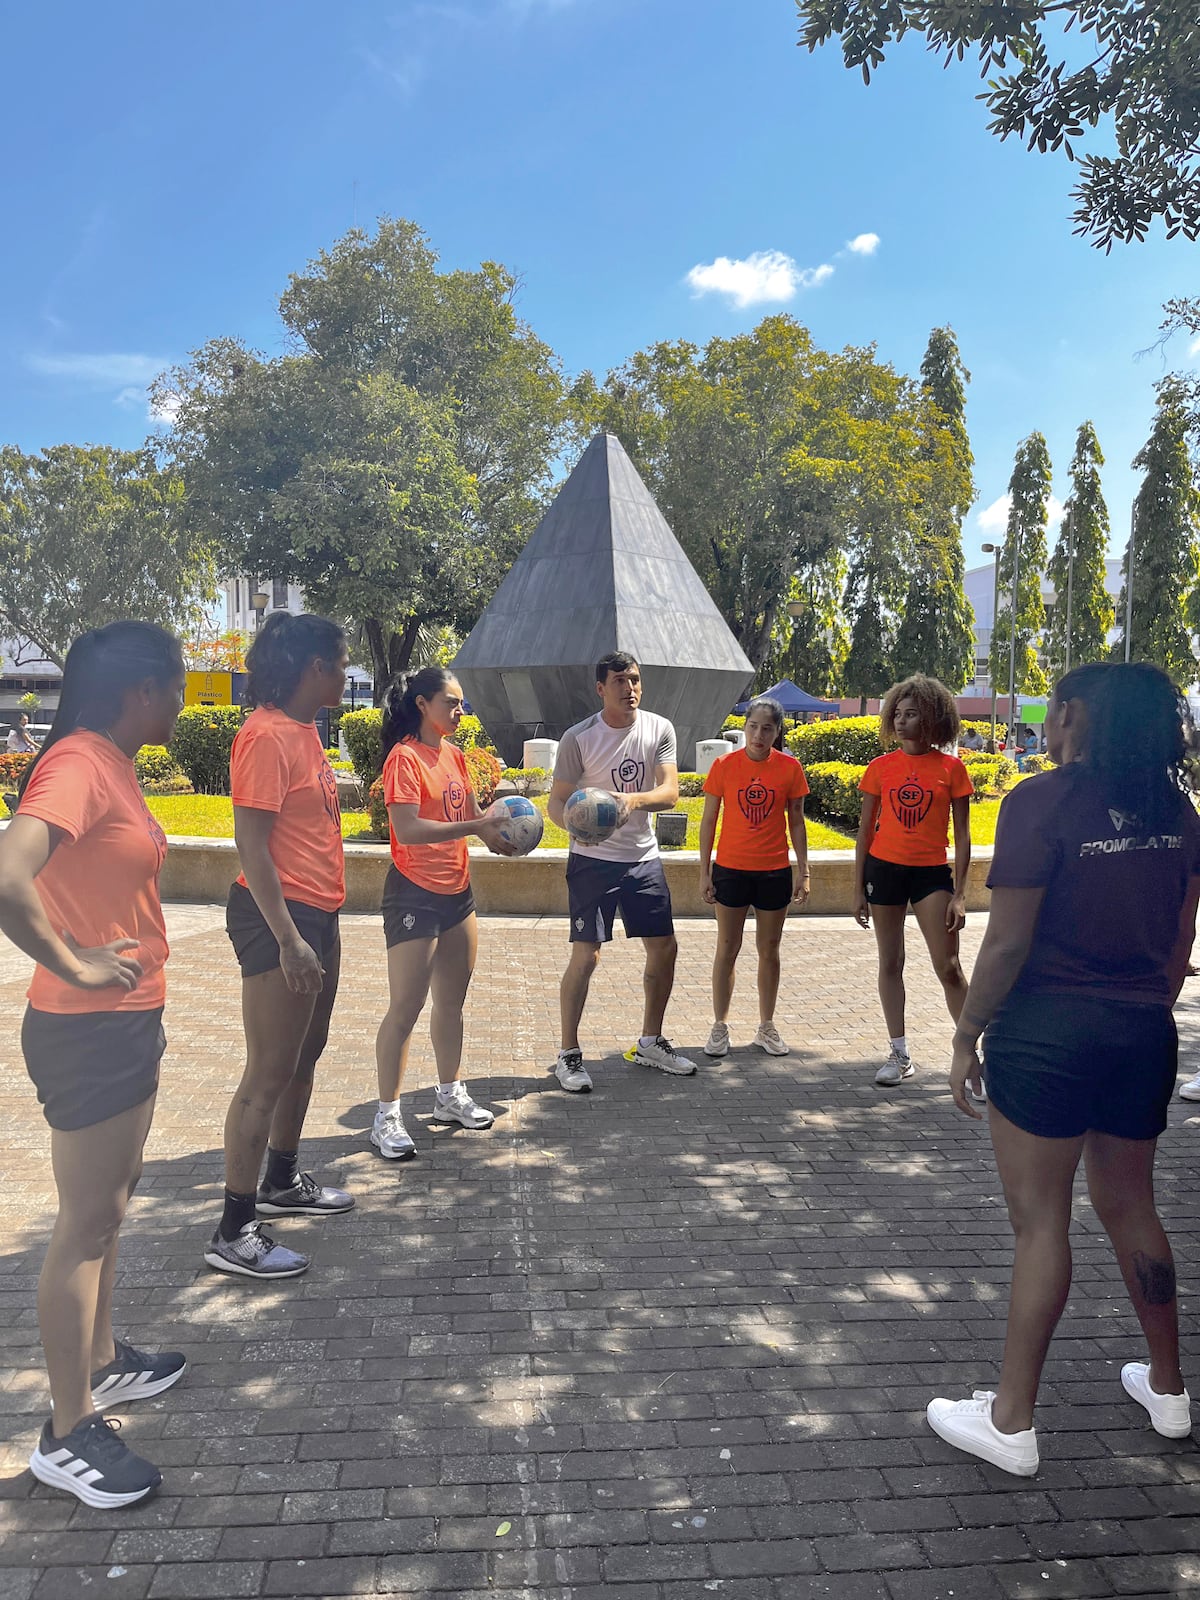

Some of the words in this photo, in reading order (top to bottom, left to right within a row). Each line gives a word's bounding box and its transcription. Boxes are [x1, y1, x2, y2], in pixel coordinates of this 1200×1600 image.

[622, 765, 635, 776] SF
[451, 789, 461, 800] SF
[749, 790, 764, 799] SF
[902, 791, 920, 800] SF
